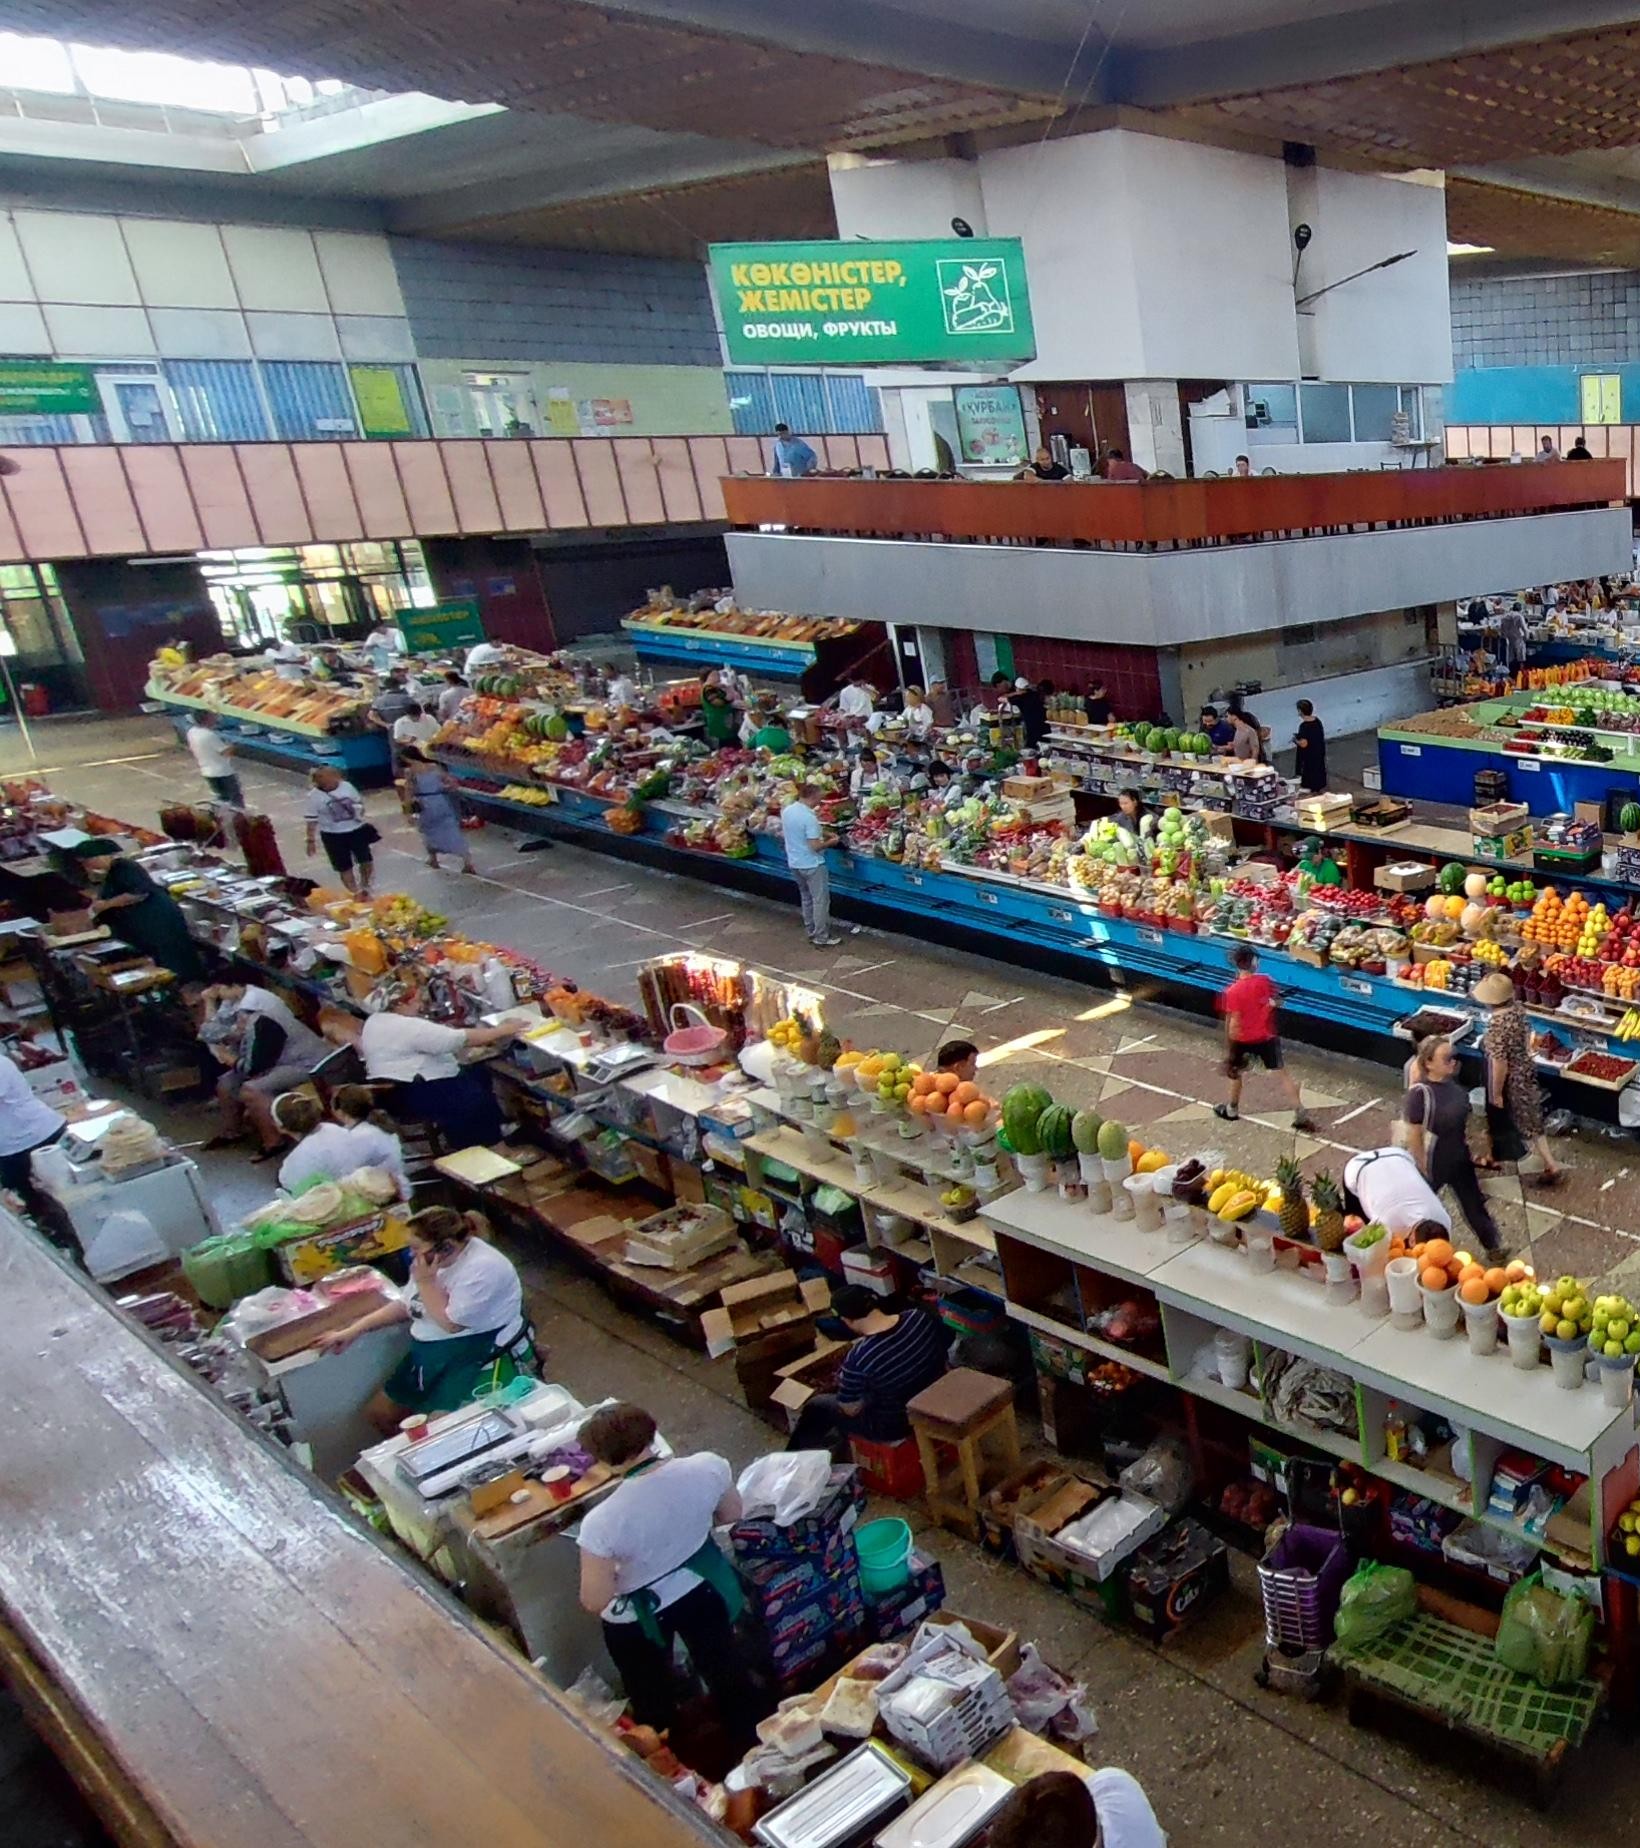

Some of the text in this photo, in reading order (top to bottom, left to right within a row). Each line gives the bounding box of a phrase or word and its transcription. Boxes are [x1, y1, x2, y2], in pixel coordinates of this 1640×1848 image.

[731, 260, 907, 287] КӨКӨНІСТЕР,
[738, 287, 872, 313] ЖЕМІСТЕР
[743, 320, 897, 340] ОВОЩИ, ФРУКТЫ
